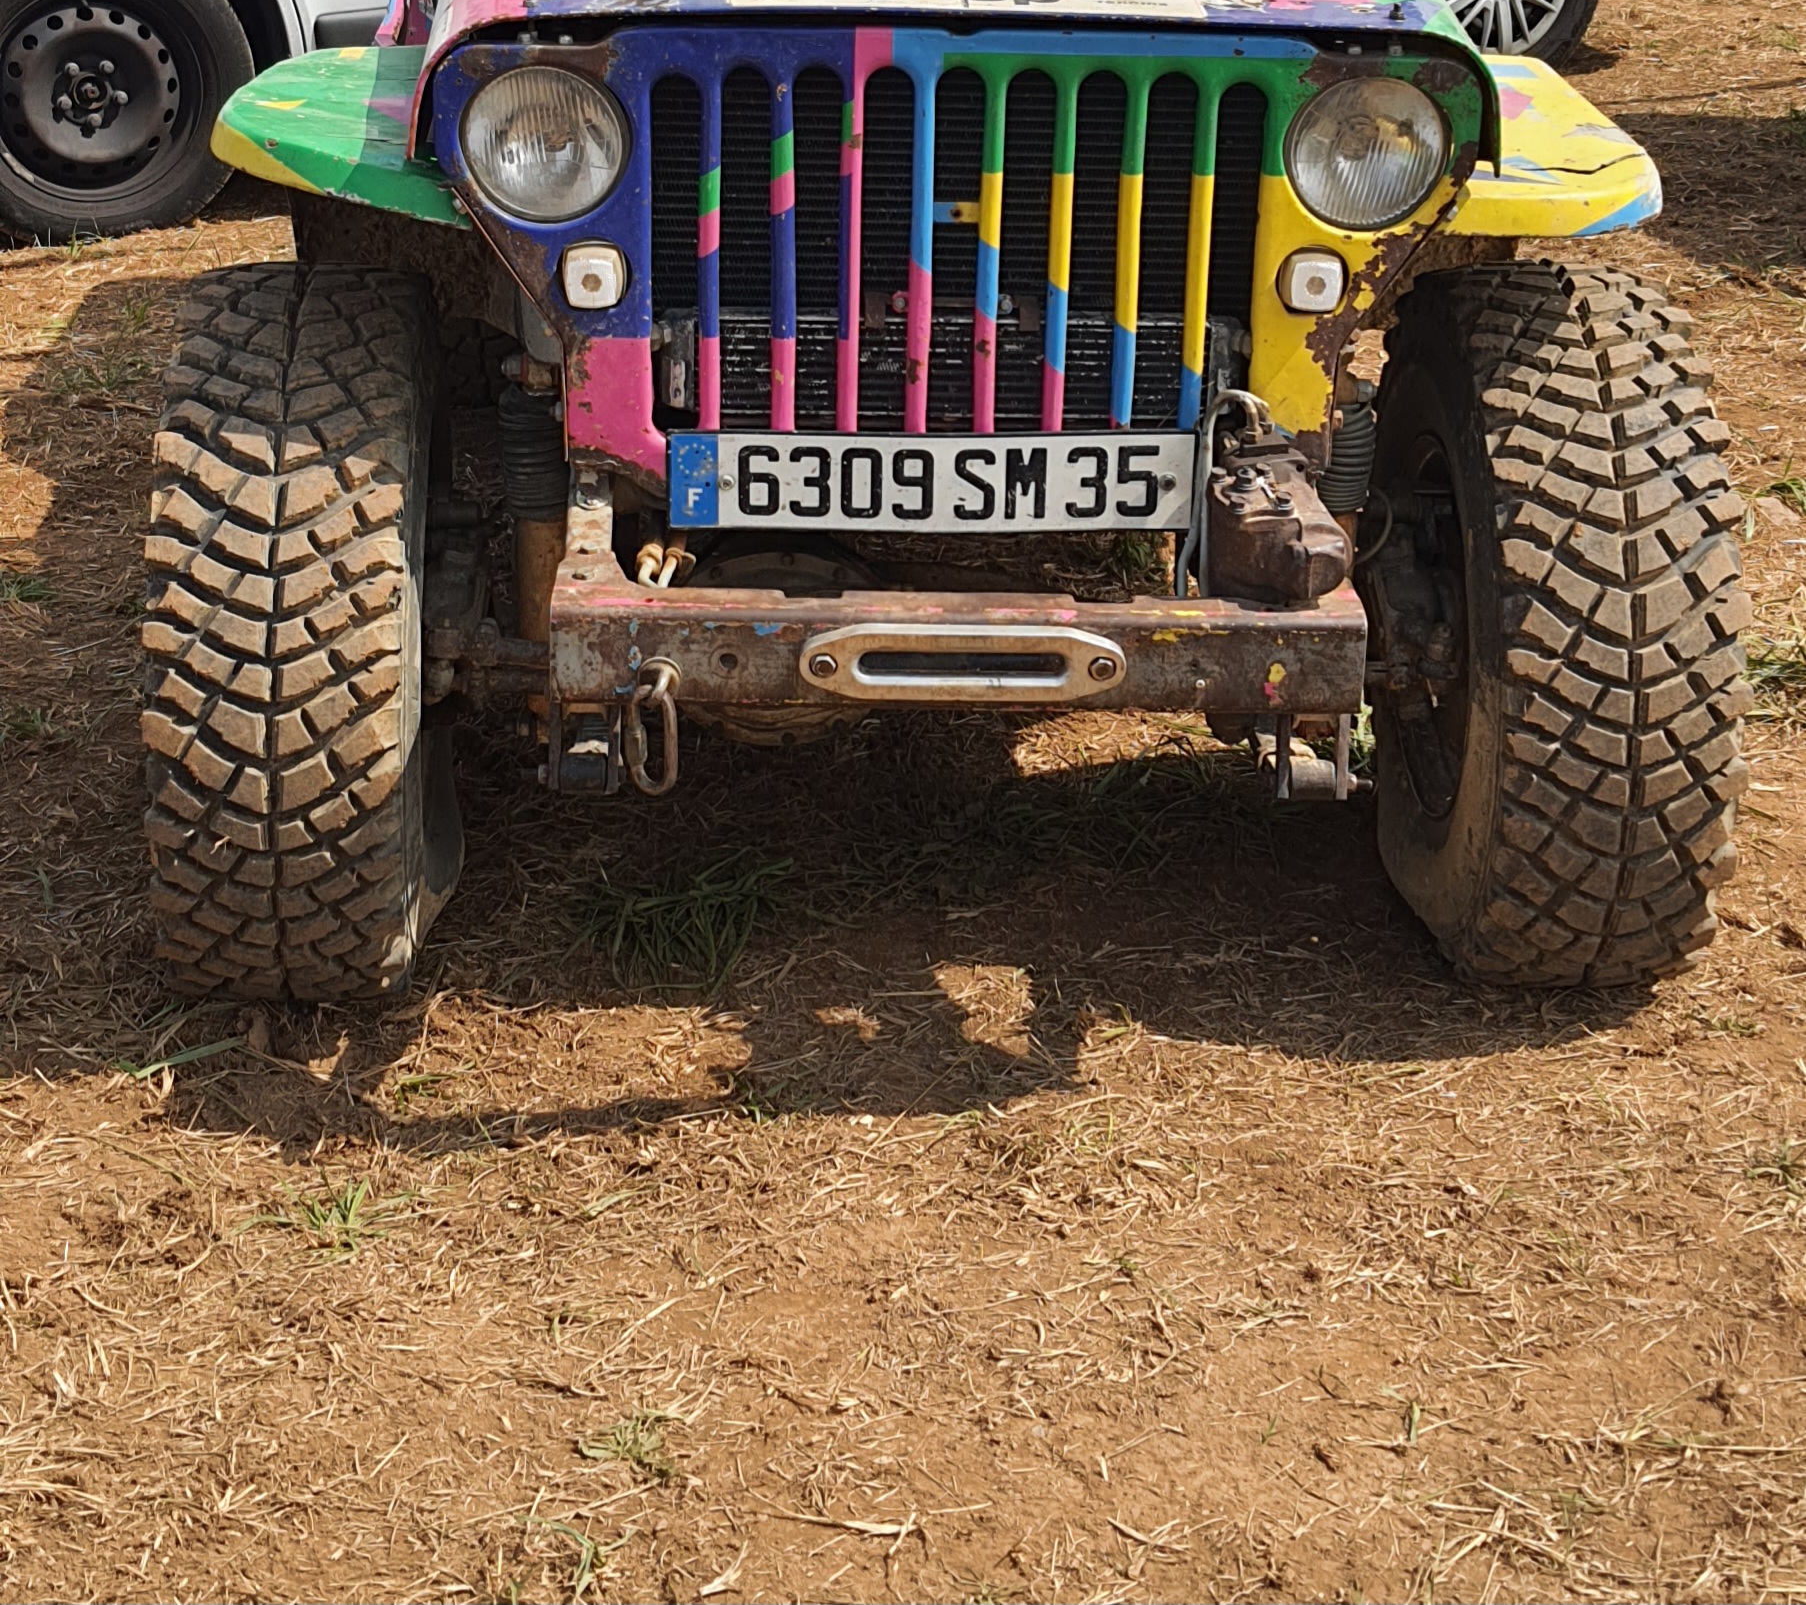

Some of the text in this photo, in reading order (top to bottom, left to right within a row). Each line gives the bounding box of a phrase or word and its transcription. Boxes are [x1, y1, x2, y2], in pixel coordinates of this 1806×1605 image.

[688, 487, 703, 509] F
[737, 444, 1161, 520] 6309 SM 35
